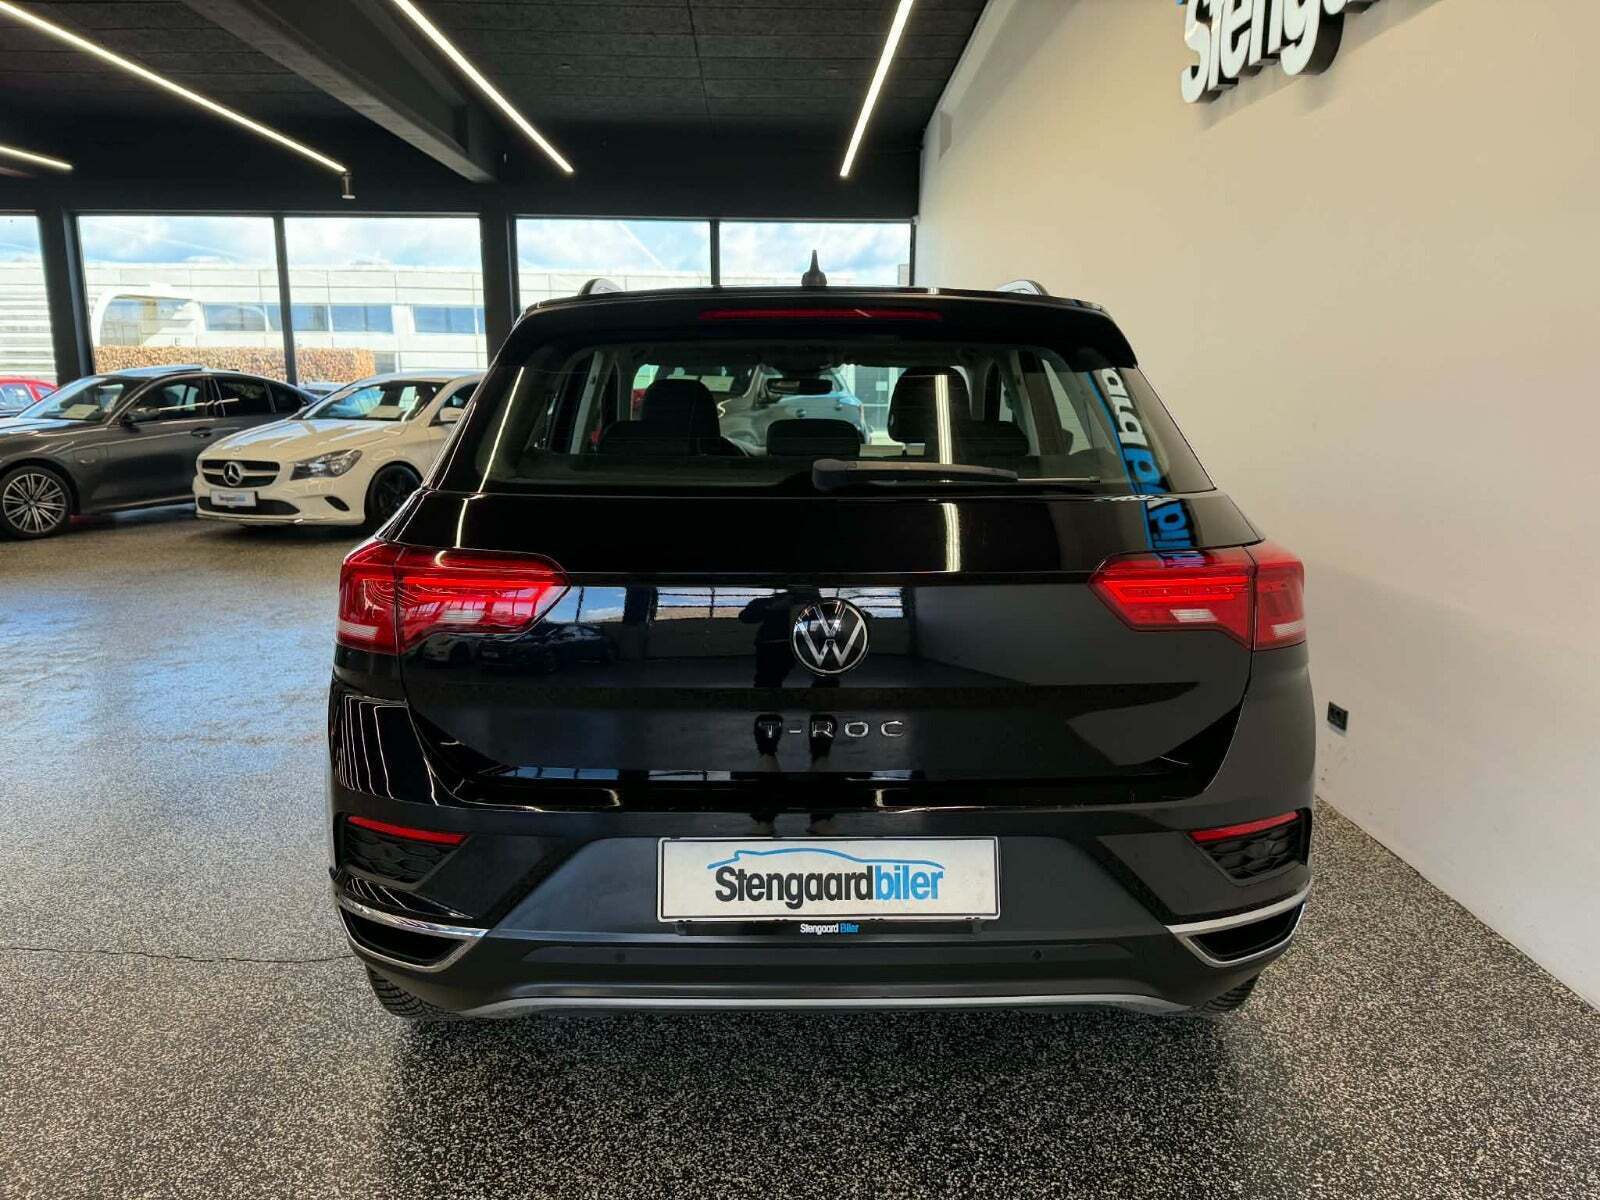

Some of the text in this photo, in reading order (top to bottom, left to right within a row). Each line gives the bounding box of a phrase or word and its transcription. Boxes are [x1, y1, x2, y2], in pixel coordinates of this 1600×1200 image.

[1181, 0, 1356, 103] Steng
[757, 720, 904, 738] T-ROC
[714, 865, 944, 910] Stengaardbiler
[800, 923, 859, 935] Stengaard Biler
